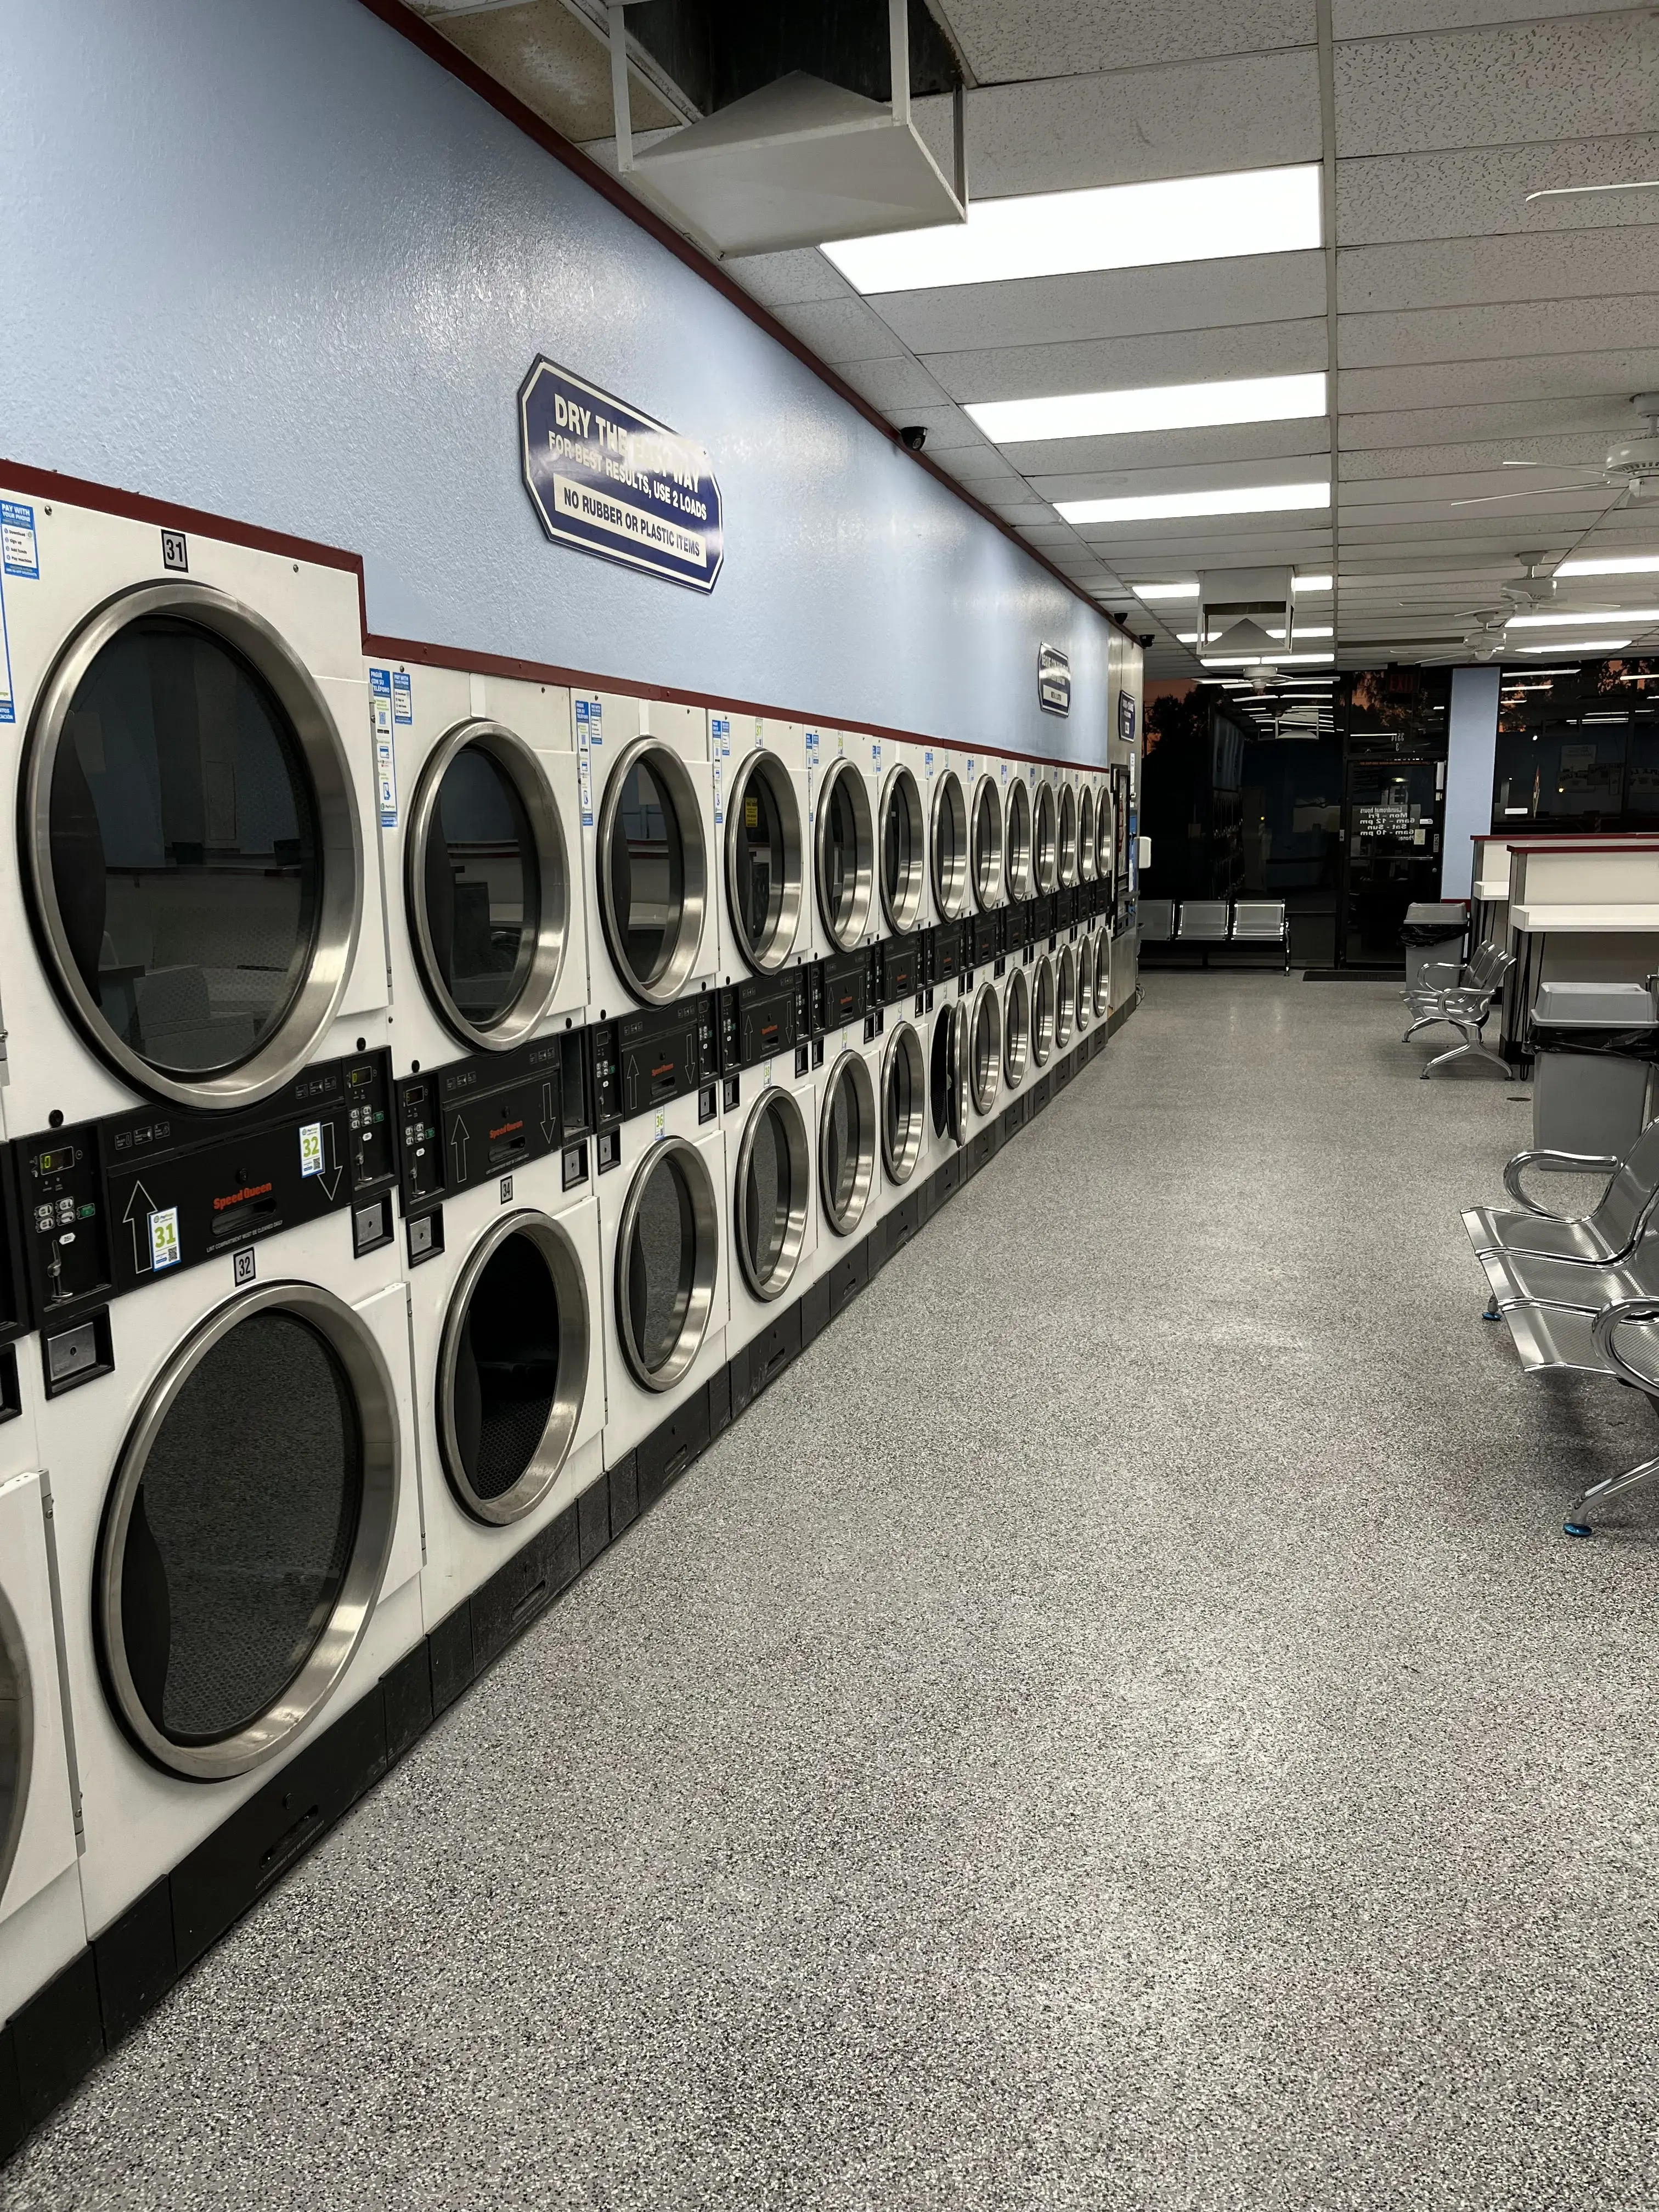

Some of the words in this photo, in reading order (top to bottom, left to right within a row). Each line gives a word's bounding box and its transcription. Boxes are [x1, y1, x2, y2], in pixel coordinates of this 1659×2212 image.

[555, 393, 591, 439] DRY
[595, 415, 628, 456] THE
[549, 431, 572, 459] FOR
[575, 443, 602, 472] BEST
[606, 458, 652, 499] RESULTS,
[654, 480, 670, 504] USE
[673, 490, 679, 508] 2
[680, 493, 707, 521] LOADS
[1, 503, 13, 513] PAY
[14, 506, 30, 516] WITH
[564, 487, 579, 509] NO
[582, 495, 623, 527] RUBBER
[625, 512, 639, 533] OR
[641, 518, 674, 546] PLASTIC
[676, 533, 700, 557] ITEMS
[166, 539, 183, 562] 31
[656, 1114, 663, 1127] 36
[303, 1136, 319, 1158] 32
[213, 1189, 243, 1210] Speed
[244, 1183, 272, 1199] Queen
[503, 1182, 510, 1198] 34
[155, 1223, 176, 1248] 31
[239, 1256, 251, 1277] 32
